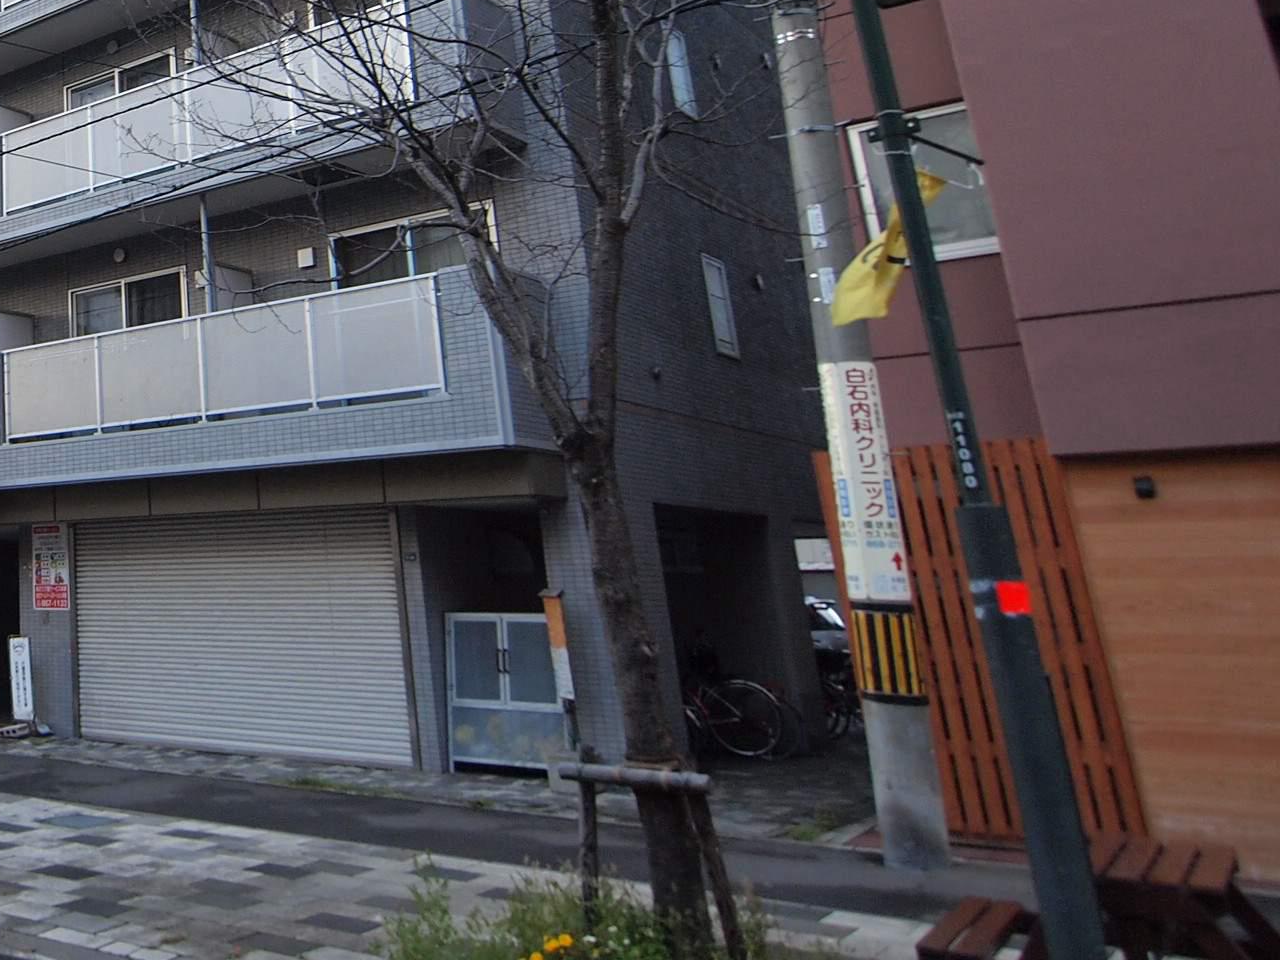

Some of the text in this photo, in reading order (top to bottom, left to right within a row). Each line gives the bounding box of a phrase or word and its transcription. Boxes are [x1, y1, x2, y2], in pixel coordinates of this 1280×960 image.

[846, 368, 883, 517] 白石内科クリニック
